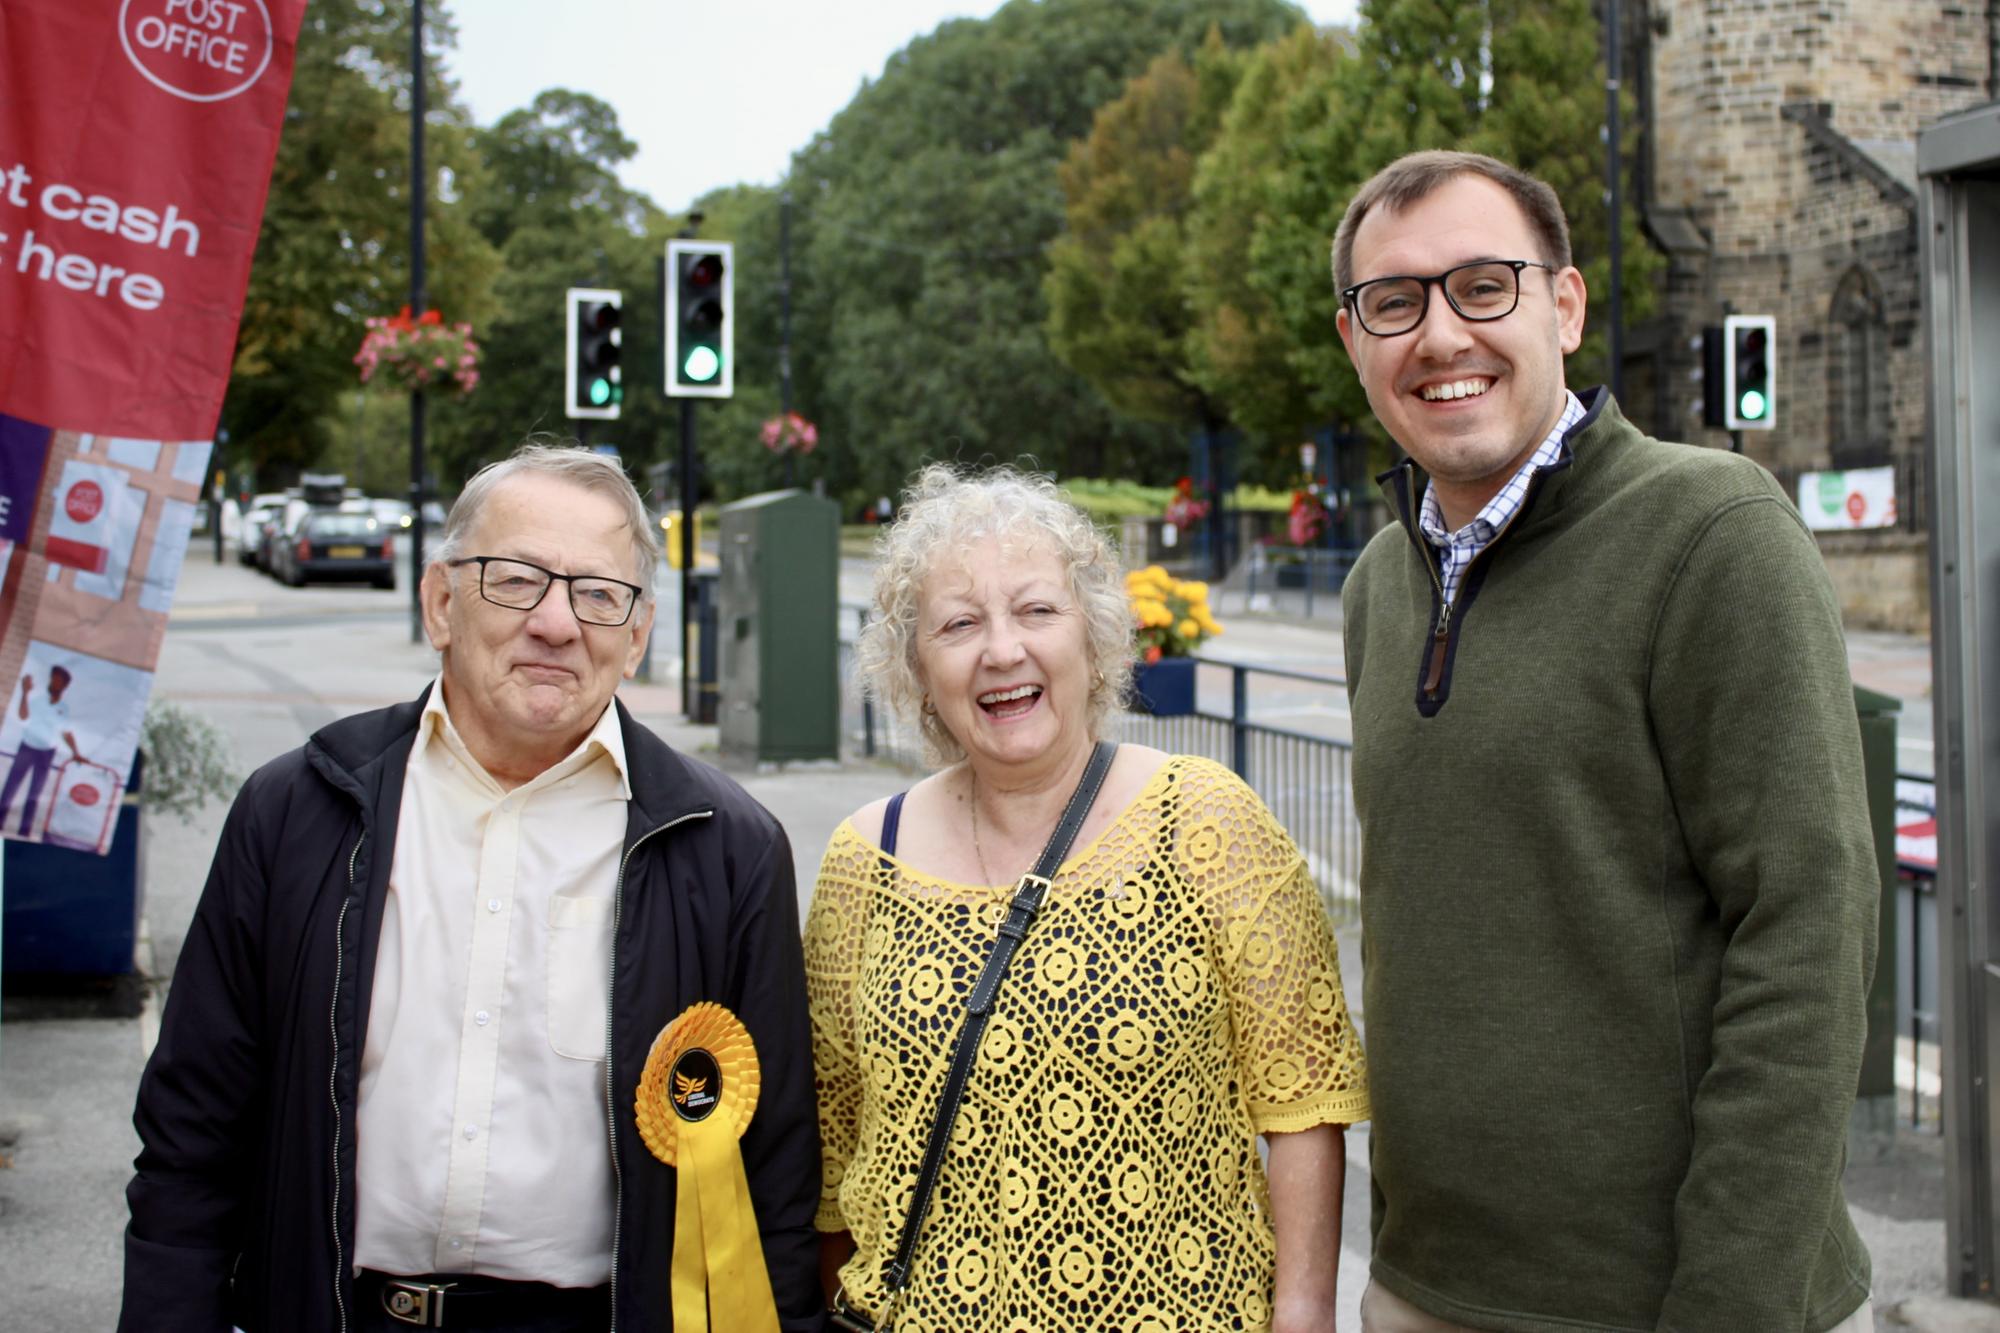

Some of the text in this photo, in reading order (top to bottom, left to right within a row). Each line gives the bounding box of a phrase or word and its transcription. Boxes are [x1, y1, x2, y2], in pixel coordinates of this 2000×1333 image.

[135, 15, 249, 75] OFFICE
[165, 0, 247, 34] POST
[40, 184, 200, 257] cash
[17, 229, 165, 311] here
